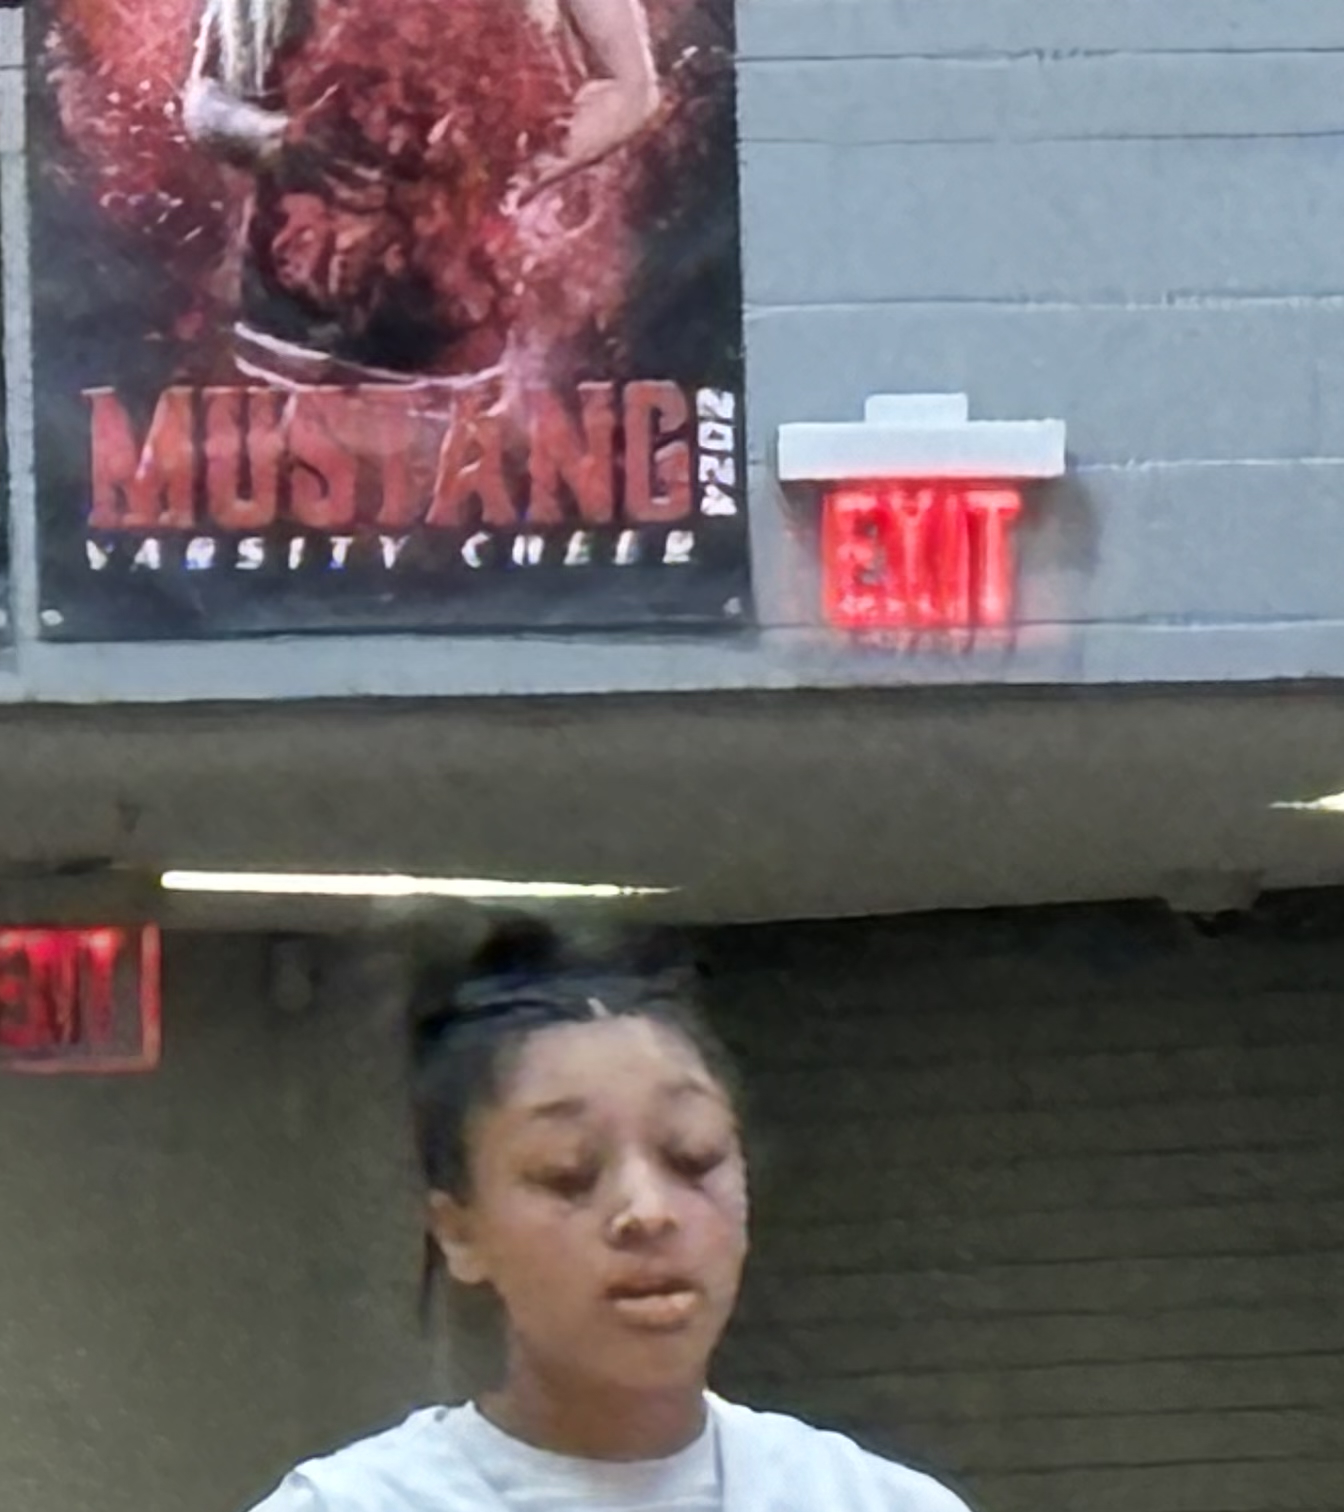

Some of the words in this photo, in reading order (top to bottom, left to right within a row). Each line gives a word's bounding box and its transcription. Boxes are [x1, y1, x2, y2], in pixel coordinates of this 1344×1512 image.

[82, 379, 692, 526] MUSTANG
[695, 386, 738, 516] 2024
[85, 533, 410, 572] VARSITY
[822, 490, 1021, 628] EXIT
